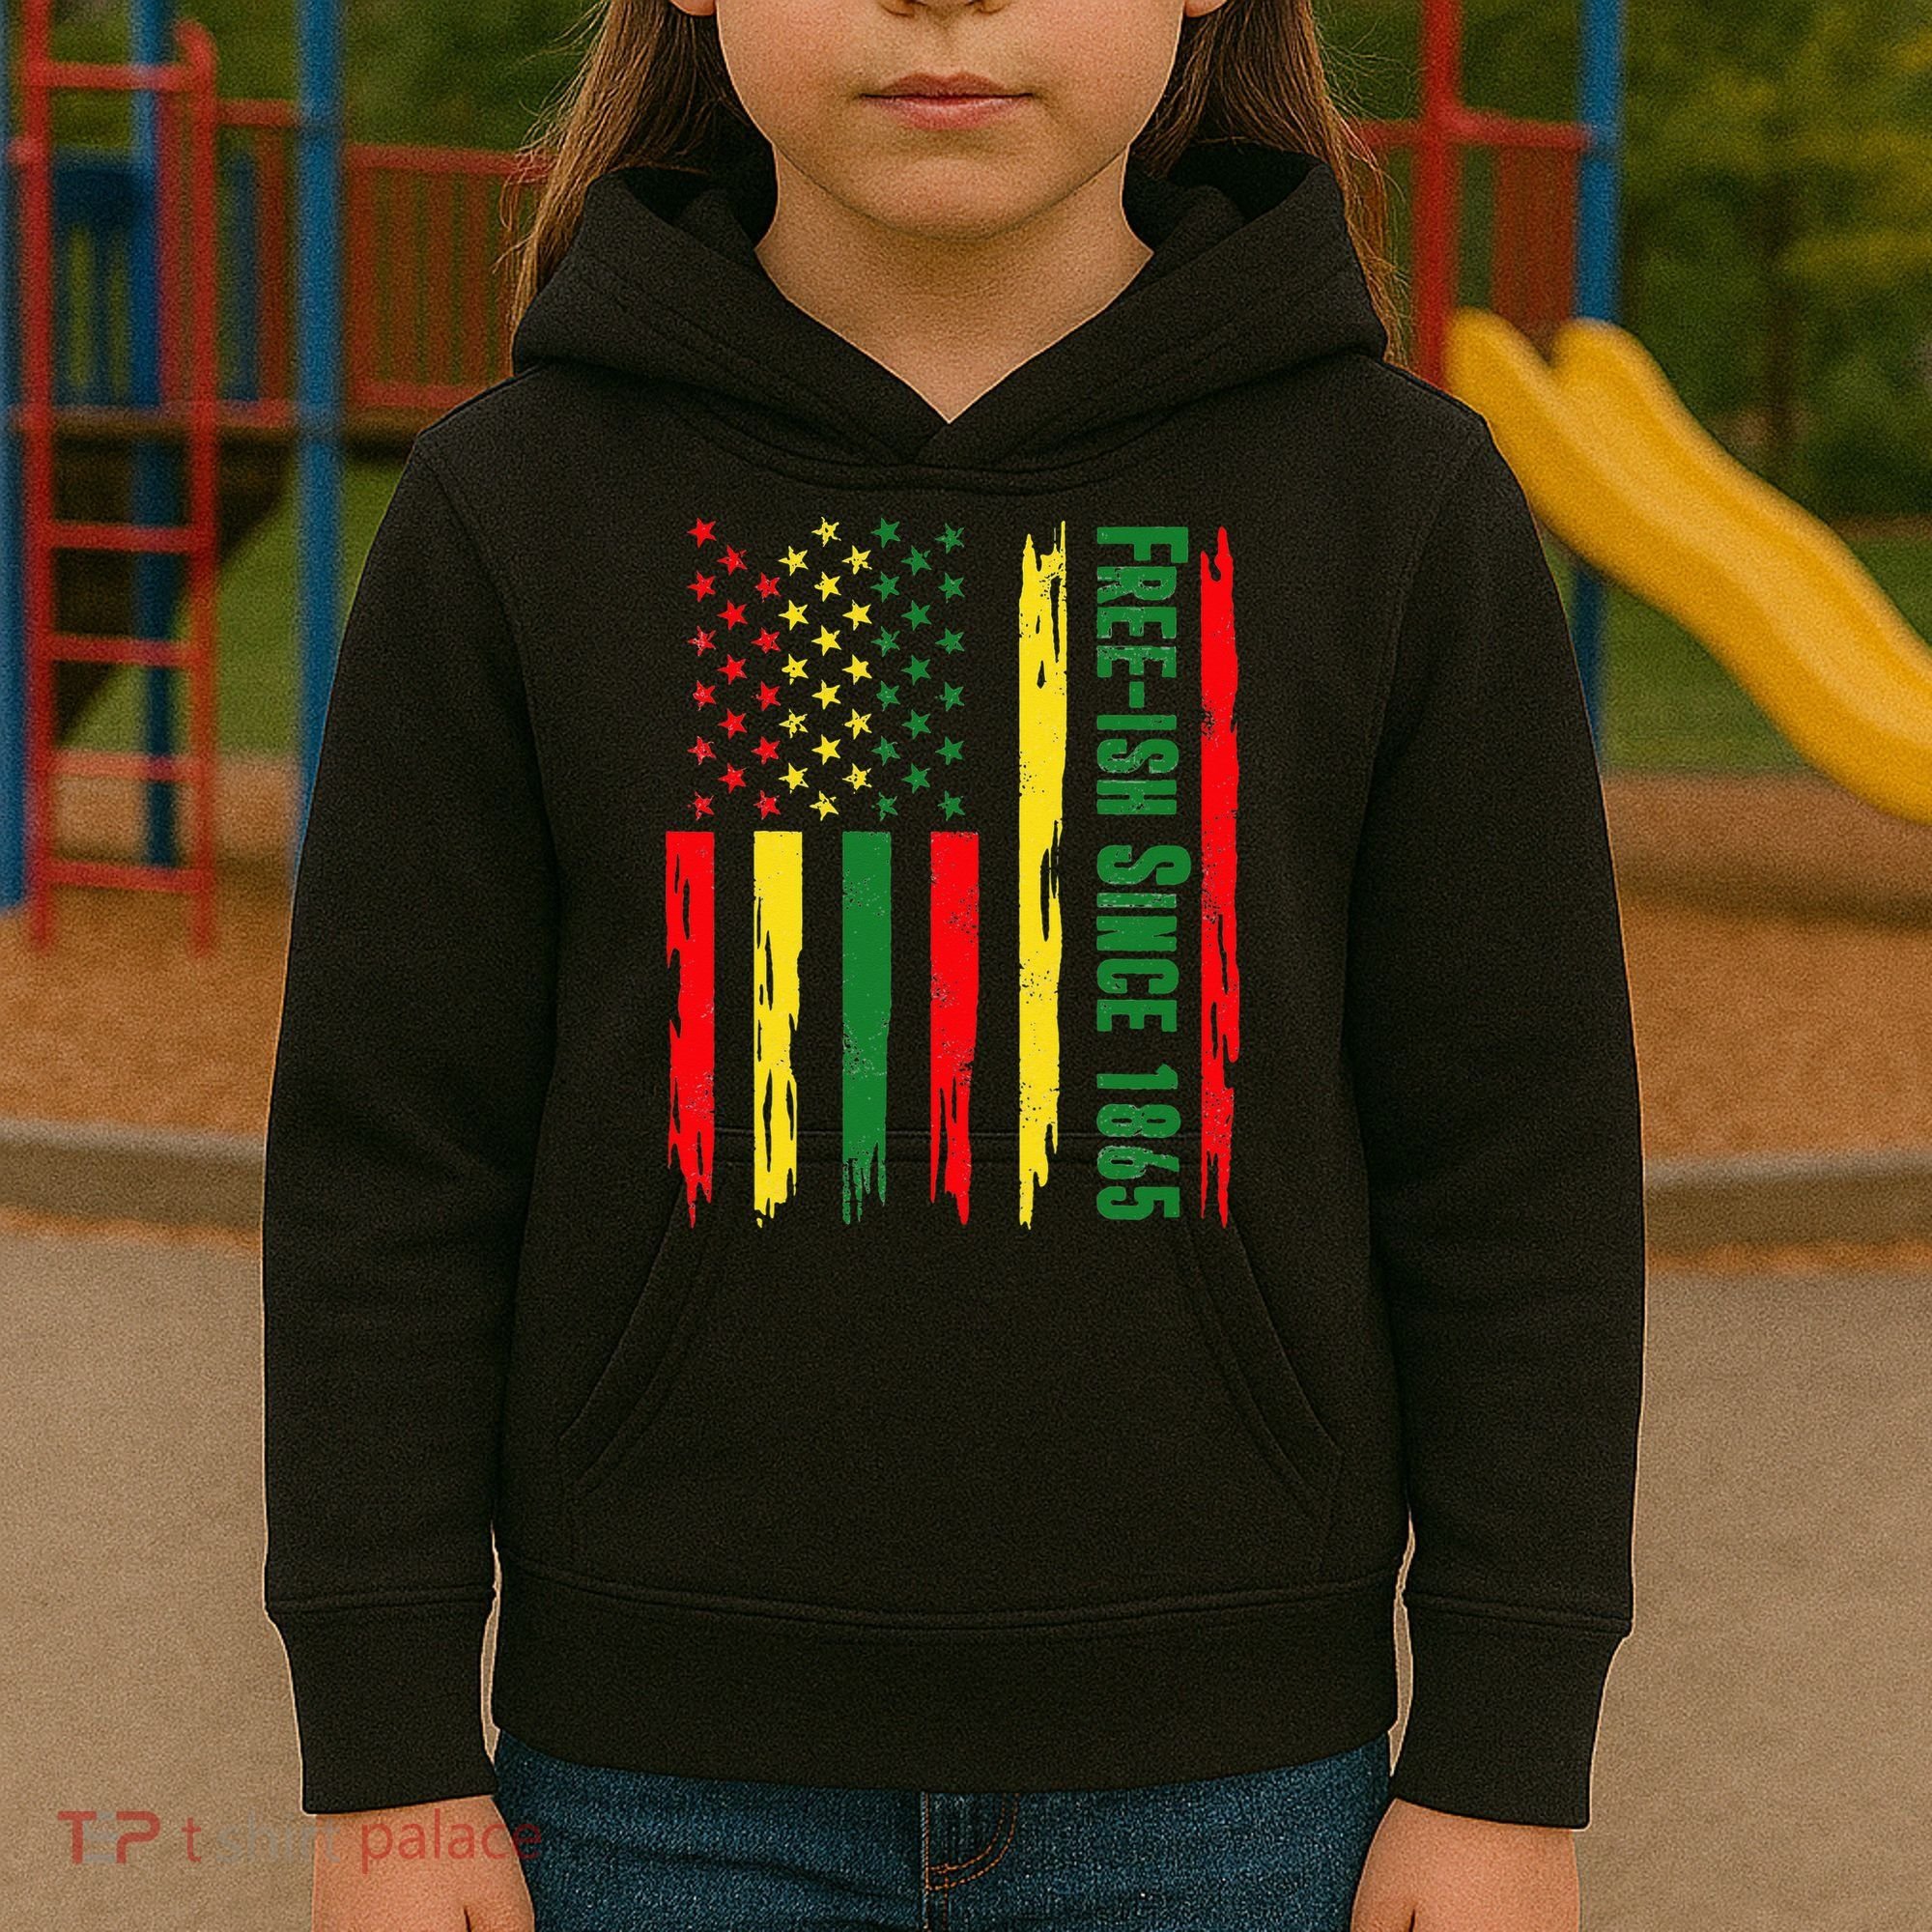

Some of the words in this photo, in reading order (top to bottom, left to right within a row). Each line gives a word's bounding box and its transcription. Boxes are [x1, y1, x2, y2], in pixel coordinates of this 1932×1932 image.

[1095, 526, 1190, 816] FREE-ISH
[1095, 844, 1192, 1034] SINCE
[1095, 1064, 1182, 1221] 1865
